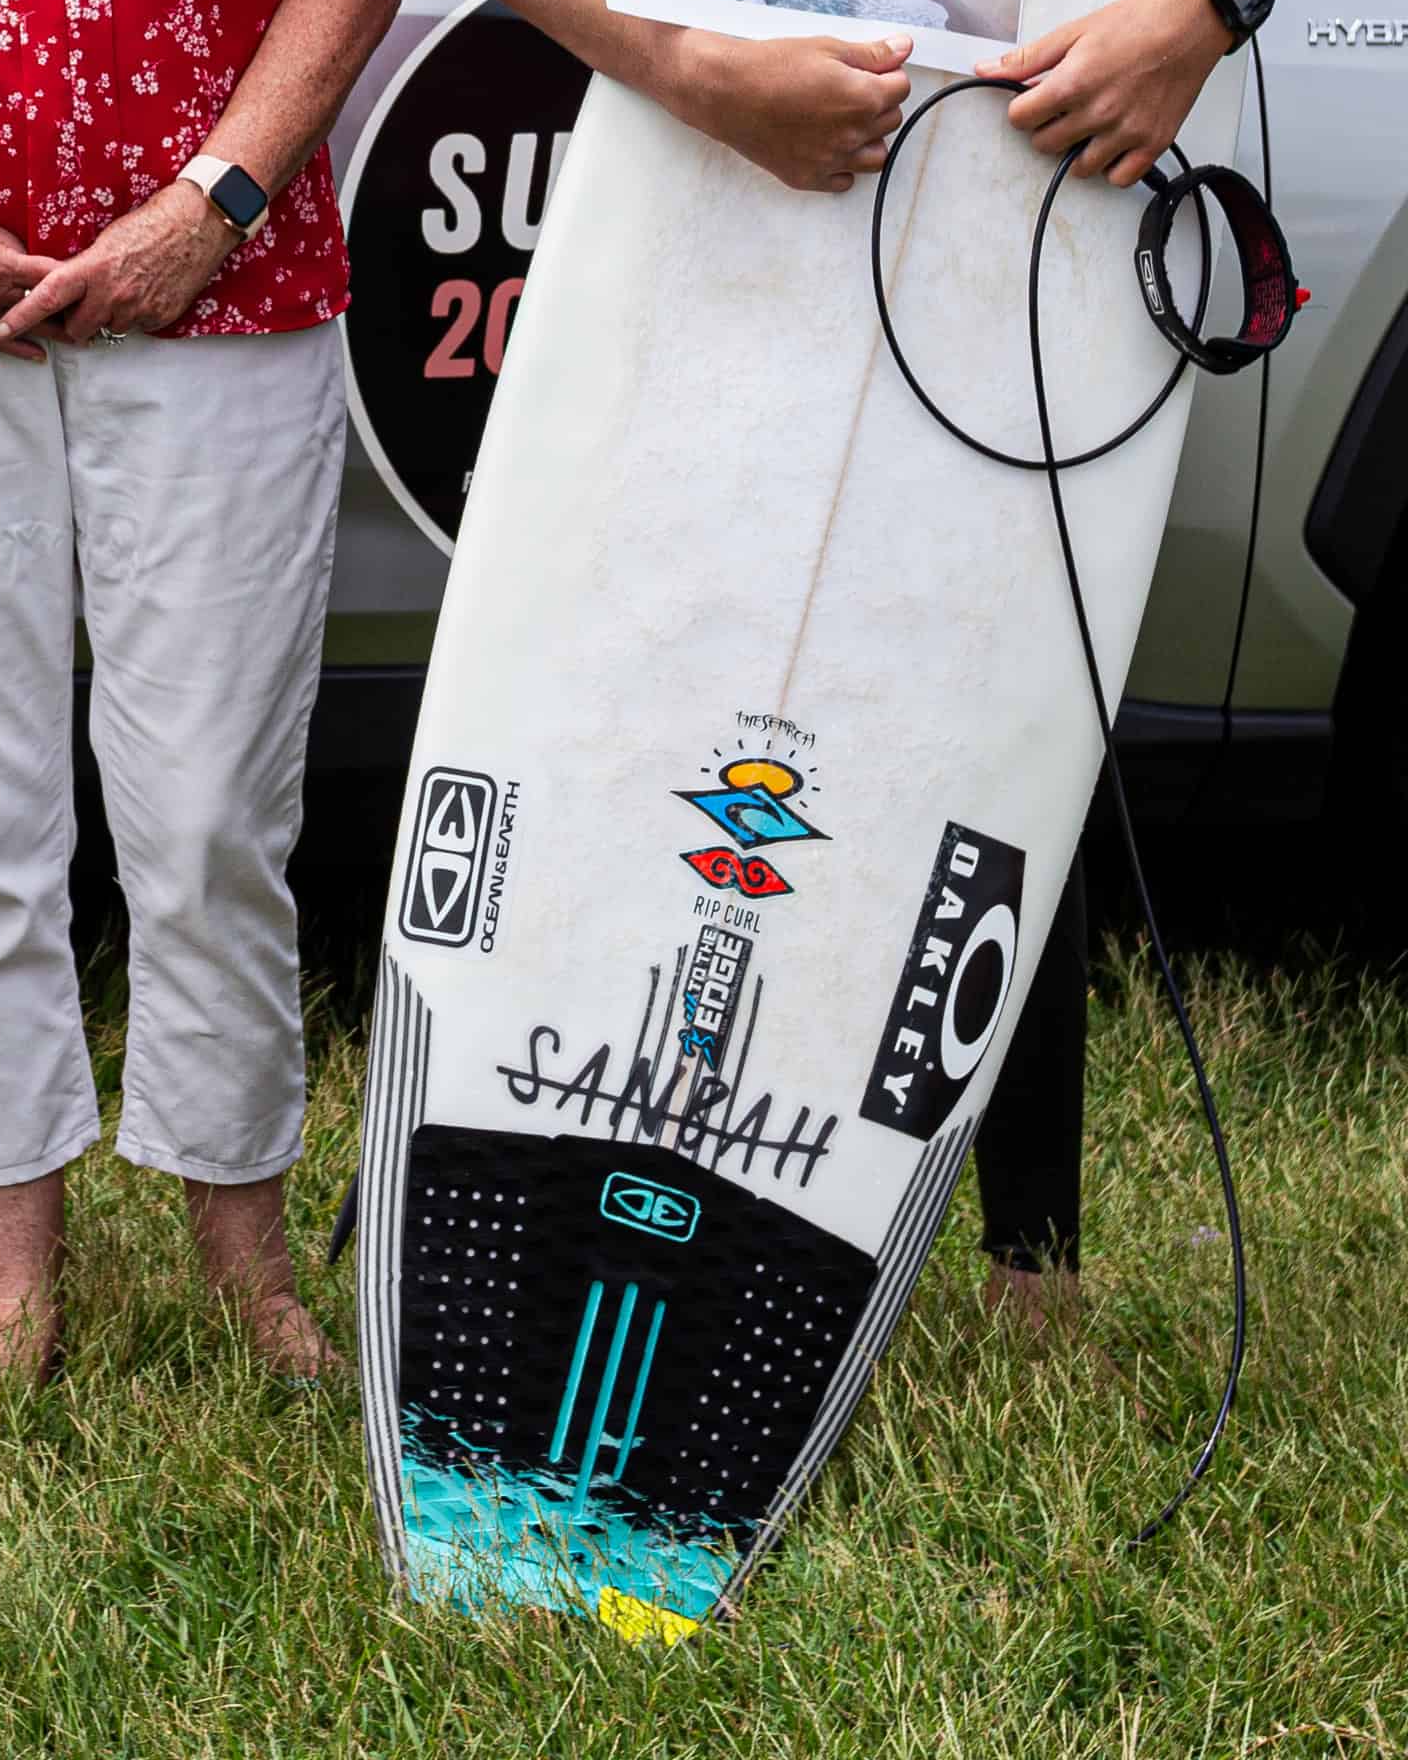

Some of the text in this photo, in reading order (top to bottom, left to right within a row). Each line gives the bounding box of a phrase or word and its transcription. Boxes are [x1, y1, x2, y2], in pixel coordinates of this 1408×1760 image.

[693, 895, 761, 933] RIP CURL
[687, 928, 718, 991] TO THE
[693, 933, 744, 1032] EDGE
[883, 841, 980, 1106] OAKLEY
